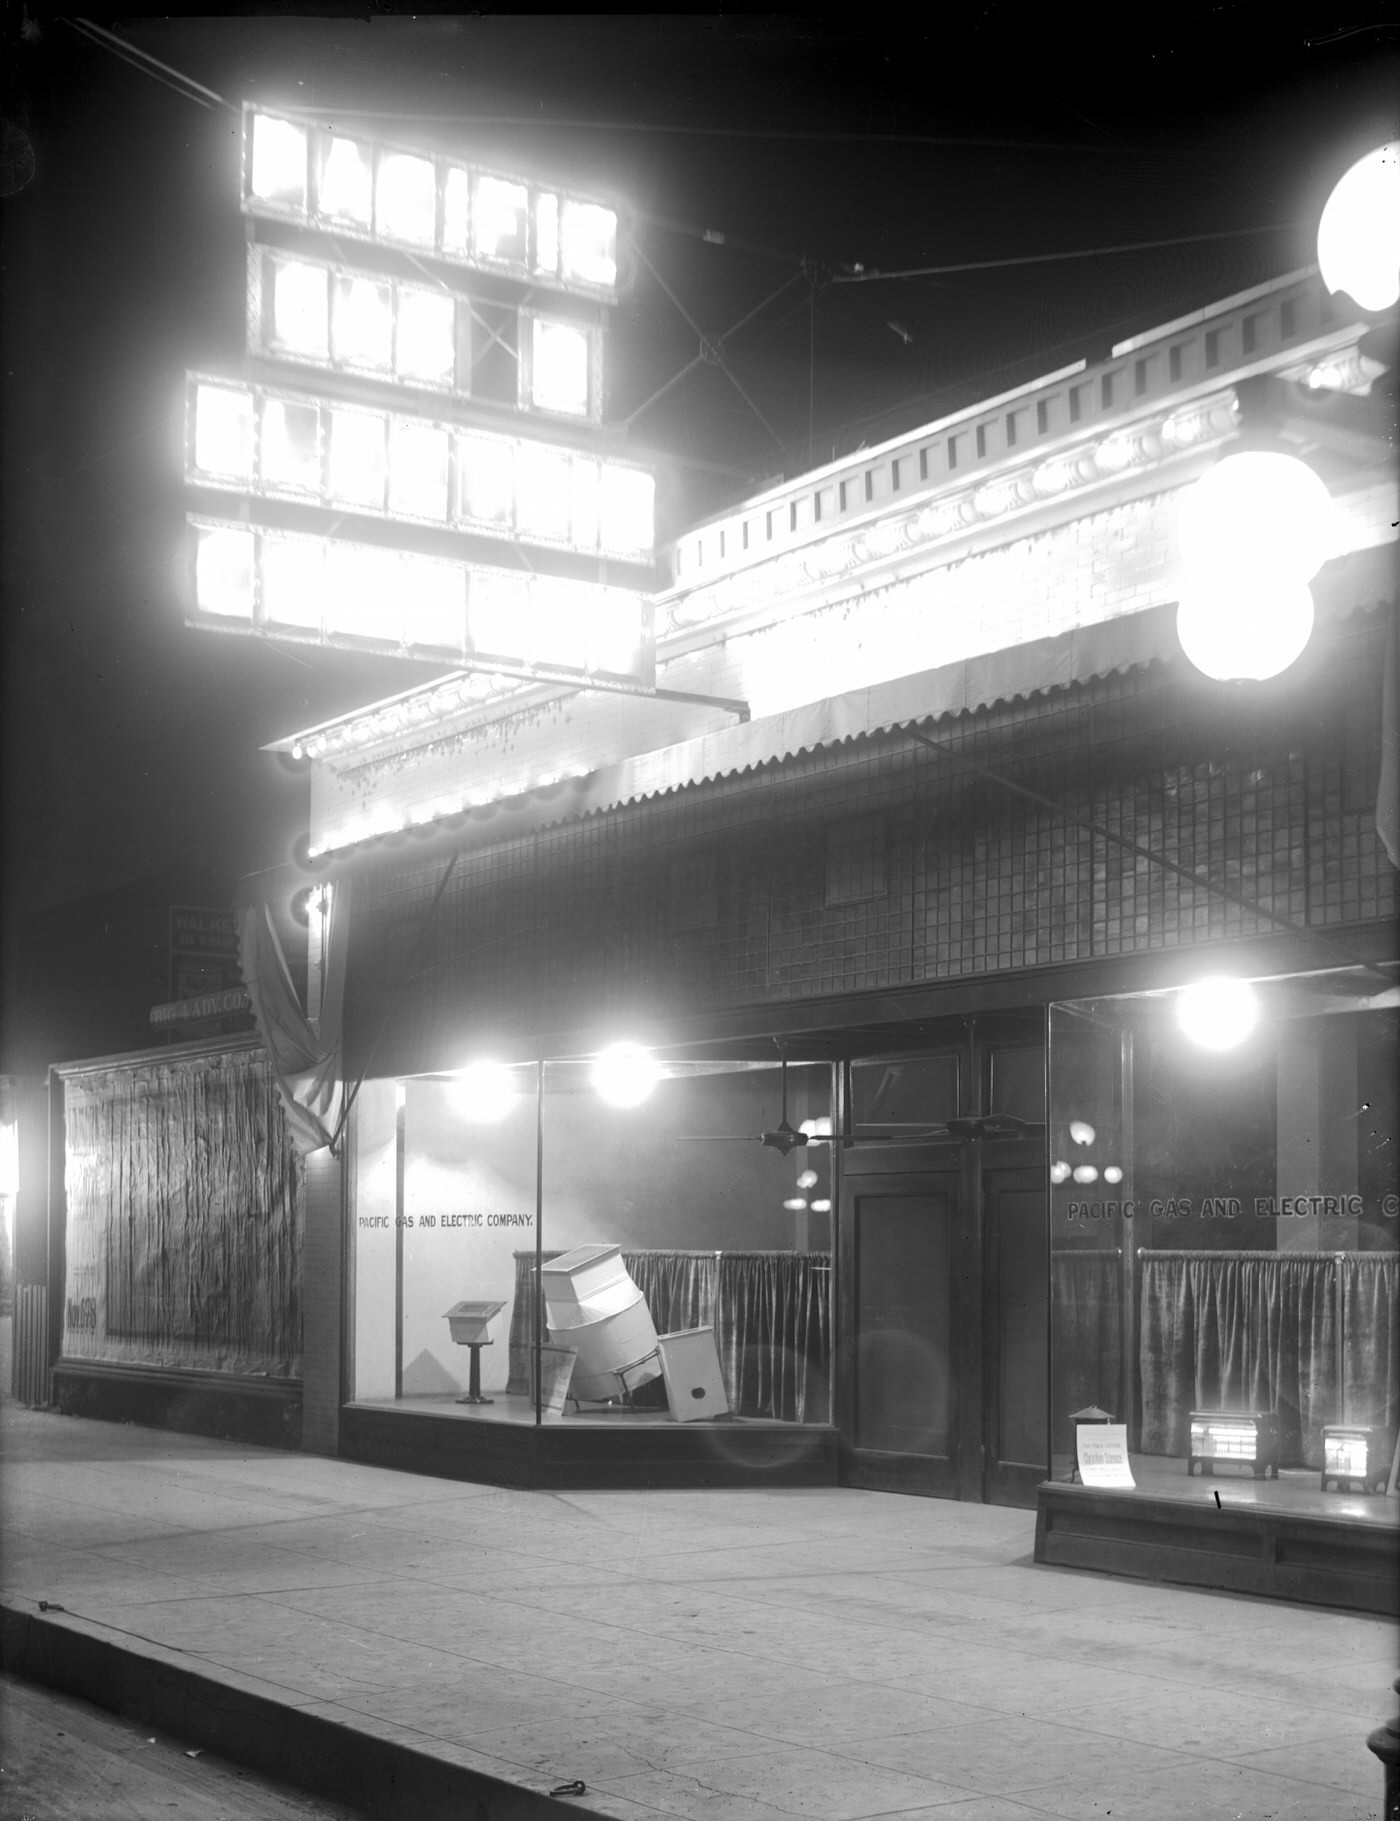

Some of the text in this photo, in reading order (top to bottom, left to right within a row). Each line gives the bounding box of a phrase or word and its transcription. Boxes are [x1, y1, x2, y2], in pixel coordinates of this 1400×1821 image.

[1067, 1201, 1135, 1220] PACIFIC
[1150, 1198, 1192, 1219] GAS
[1200, 1197, 1241, 1218] AND
[1254, 1195, 1363, 1217] ELECTRIC
[358, 1213, 533, 1228] PACIFIC GAS AND ELECTRIC COMPANY.
